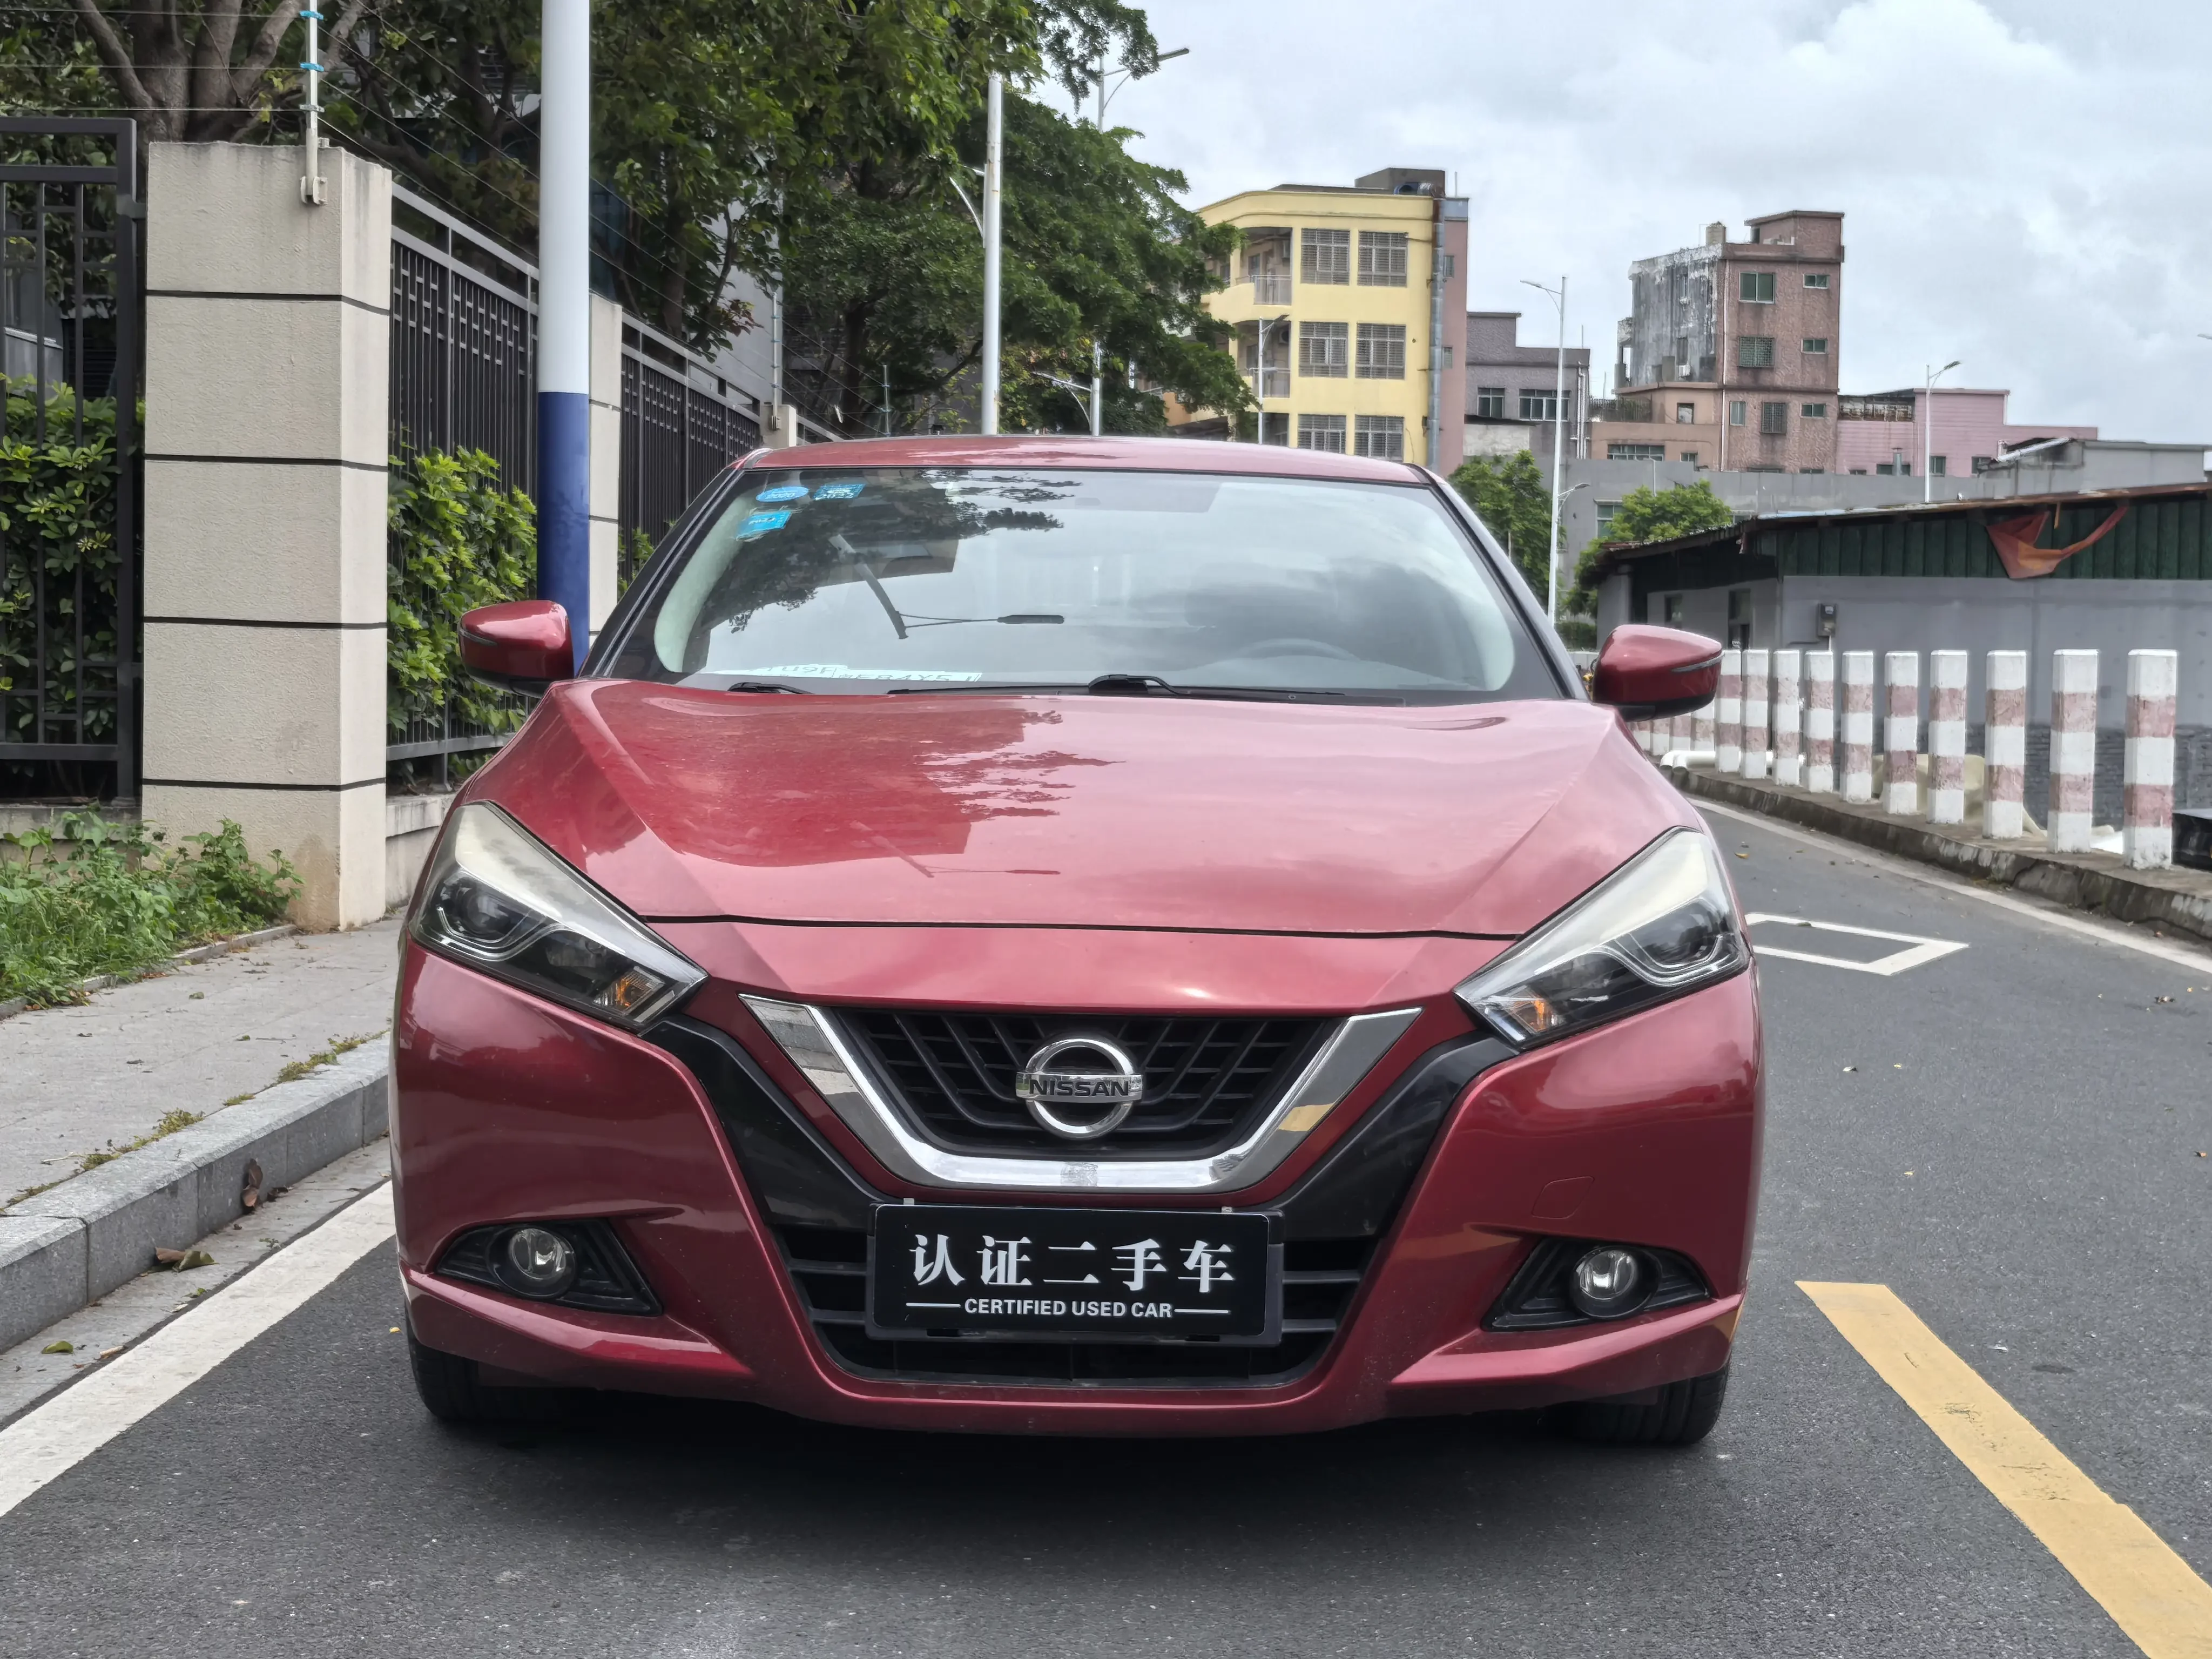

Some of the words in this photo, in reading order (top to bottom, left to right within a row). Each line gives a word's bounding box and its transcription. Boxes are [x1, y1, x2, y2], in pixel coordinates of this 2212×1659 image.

[1029, 1079, 1129, 1096] NISSAN
[908, 1234, 1235, 1293] 认证二手车
[965, 1298, 1066, 1316] CERTIFIED
[1071, 1301, 1127, 1317] USED
[1131, 1302, 1171, 1318] CAR
